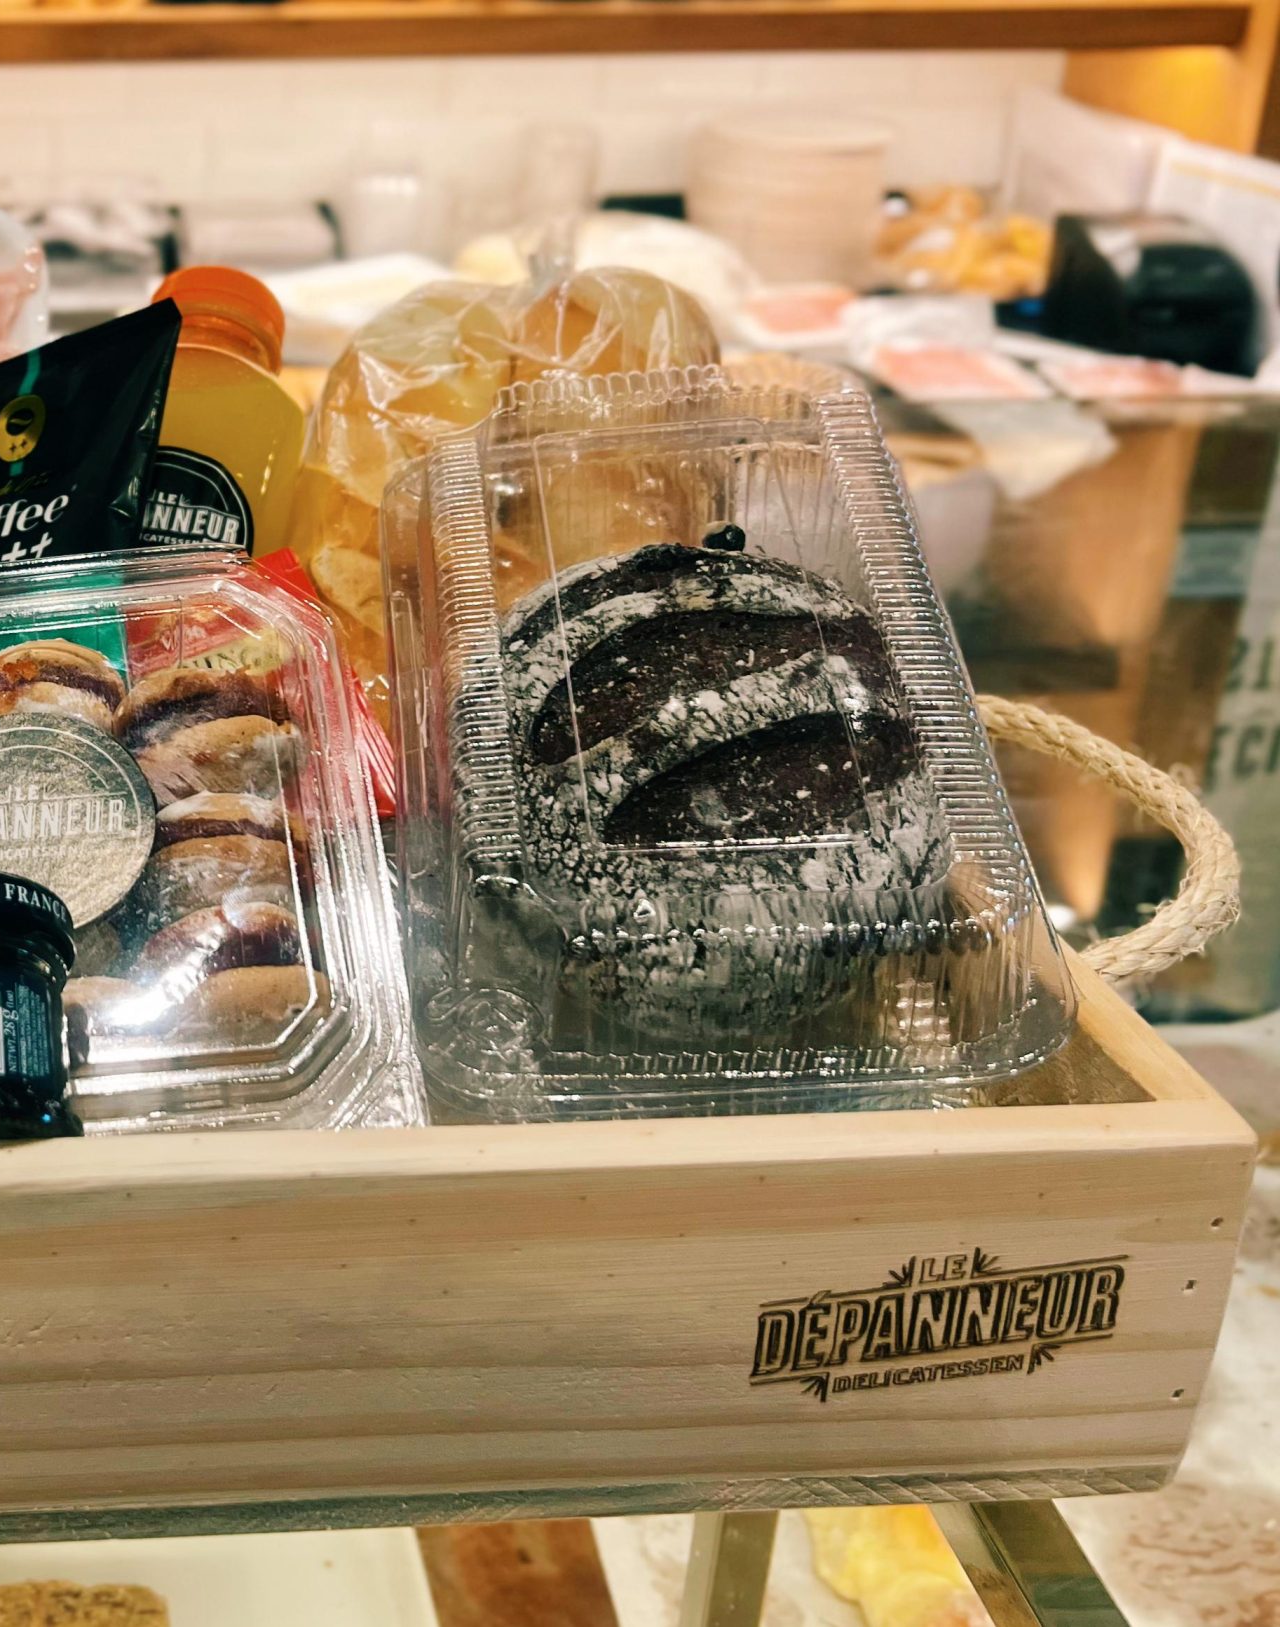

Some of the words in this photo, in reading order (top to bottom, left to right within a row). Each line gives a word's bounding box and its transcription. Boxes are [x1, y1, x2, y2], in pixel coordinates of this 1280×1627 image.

[157, 491, 179, 505] LE
[4, 882, 68, 923] FRANCE
[919, 1253, 968, 1283] LE
[751, 1264, 1127, 1377] DÉPANNEUR
[832, 1353, 1025, 1393] DELICATESSEN
